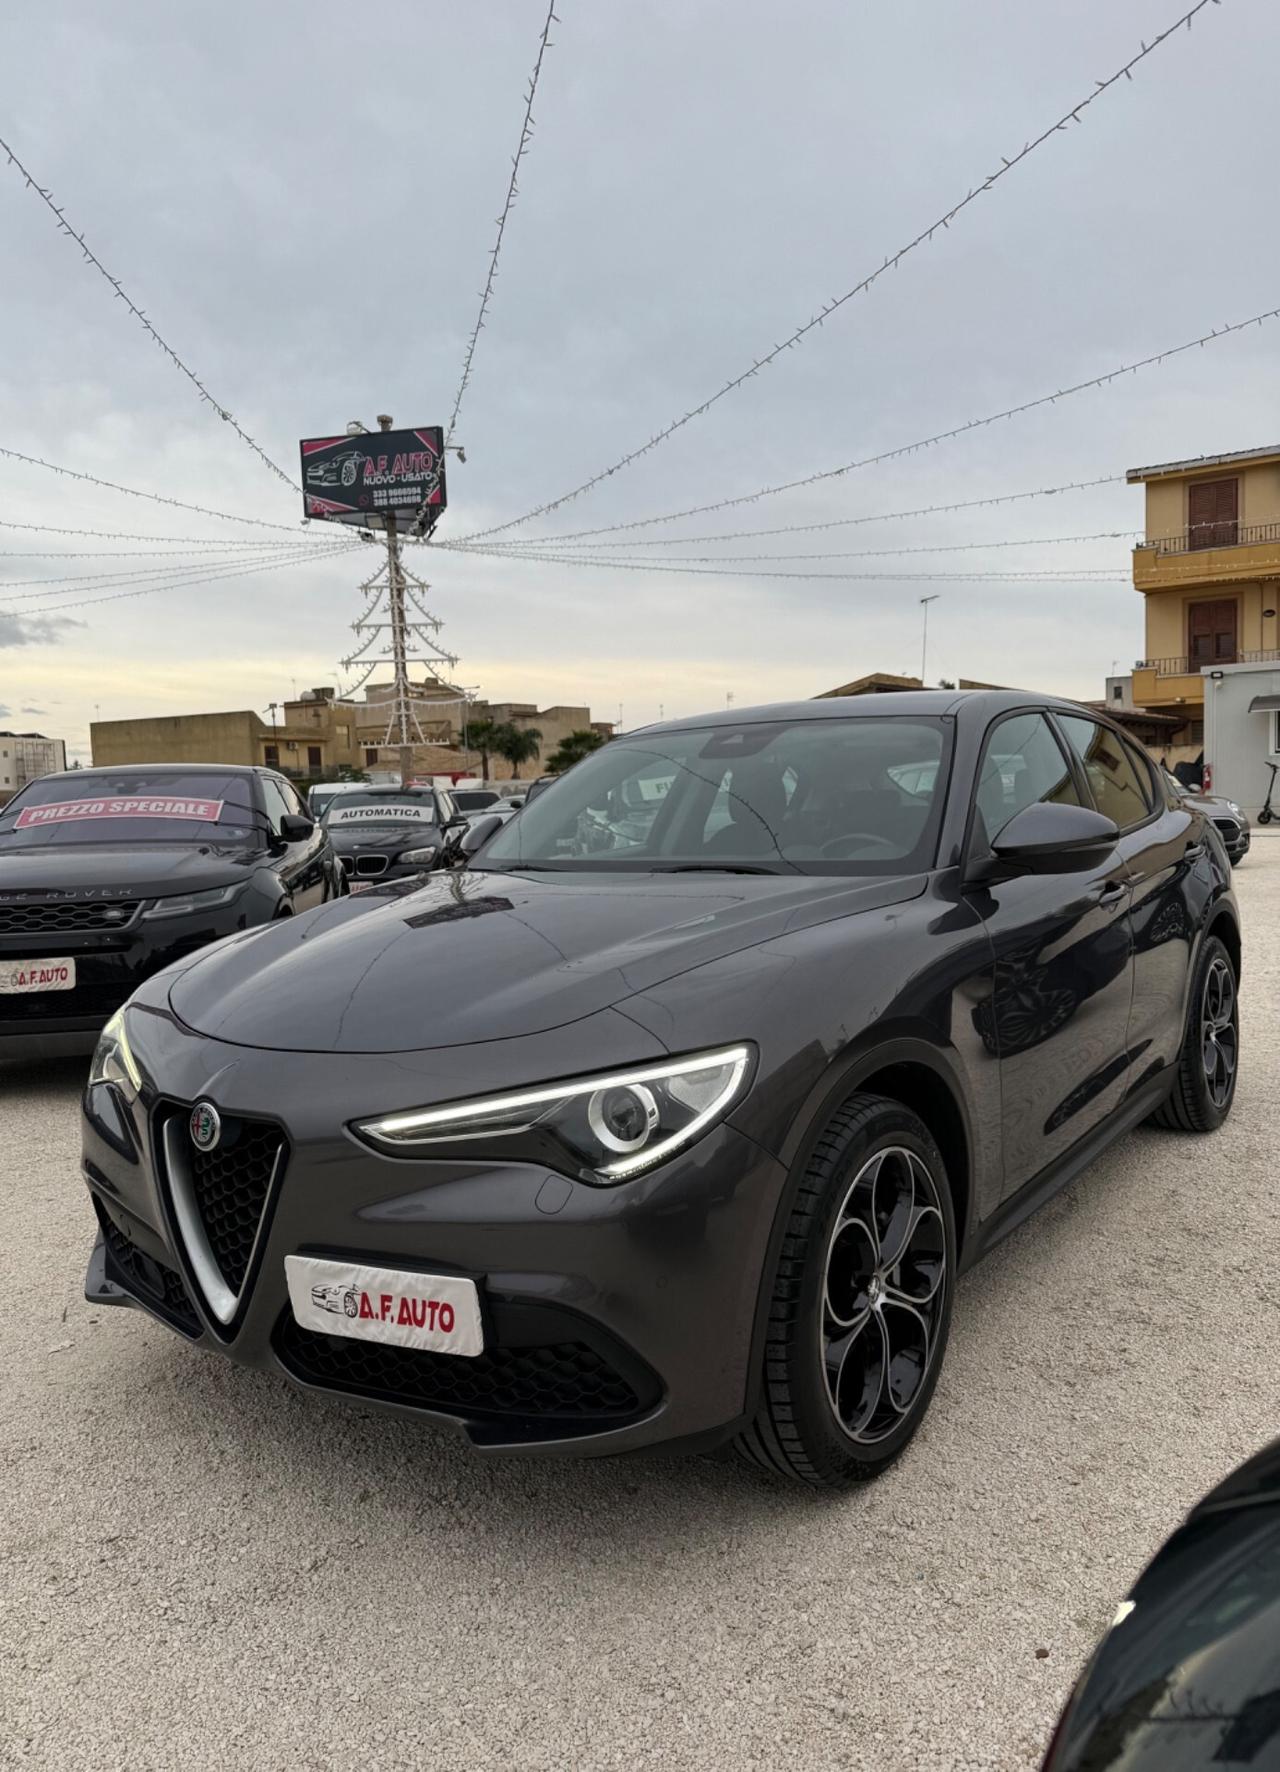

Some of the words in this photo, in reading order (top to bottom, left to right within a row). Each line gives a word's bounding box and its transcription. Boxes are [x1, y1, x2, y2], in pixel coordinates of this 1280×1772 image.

[392, 451, 433, 475] AUTO
[28, 801, 103, 822] PREZZO
[109, 801, 209, 816] SPECIALE
[341, 808, 421, 820] AUTOMATICA
